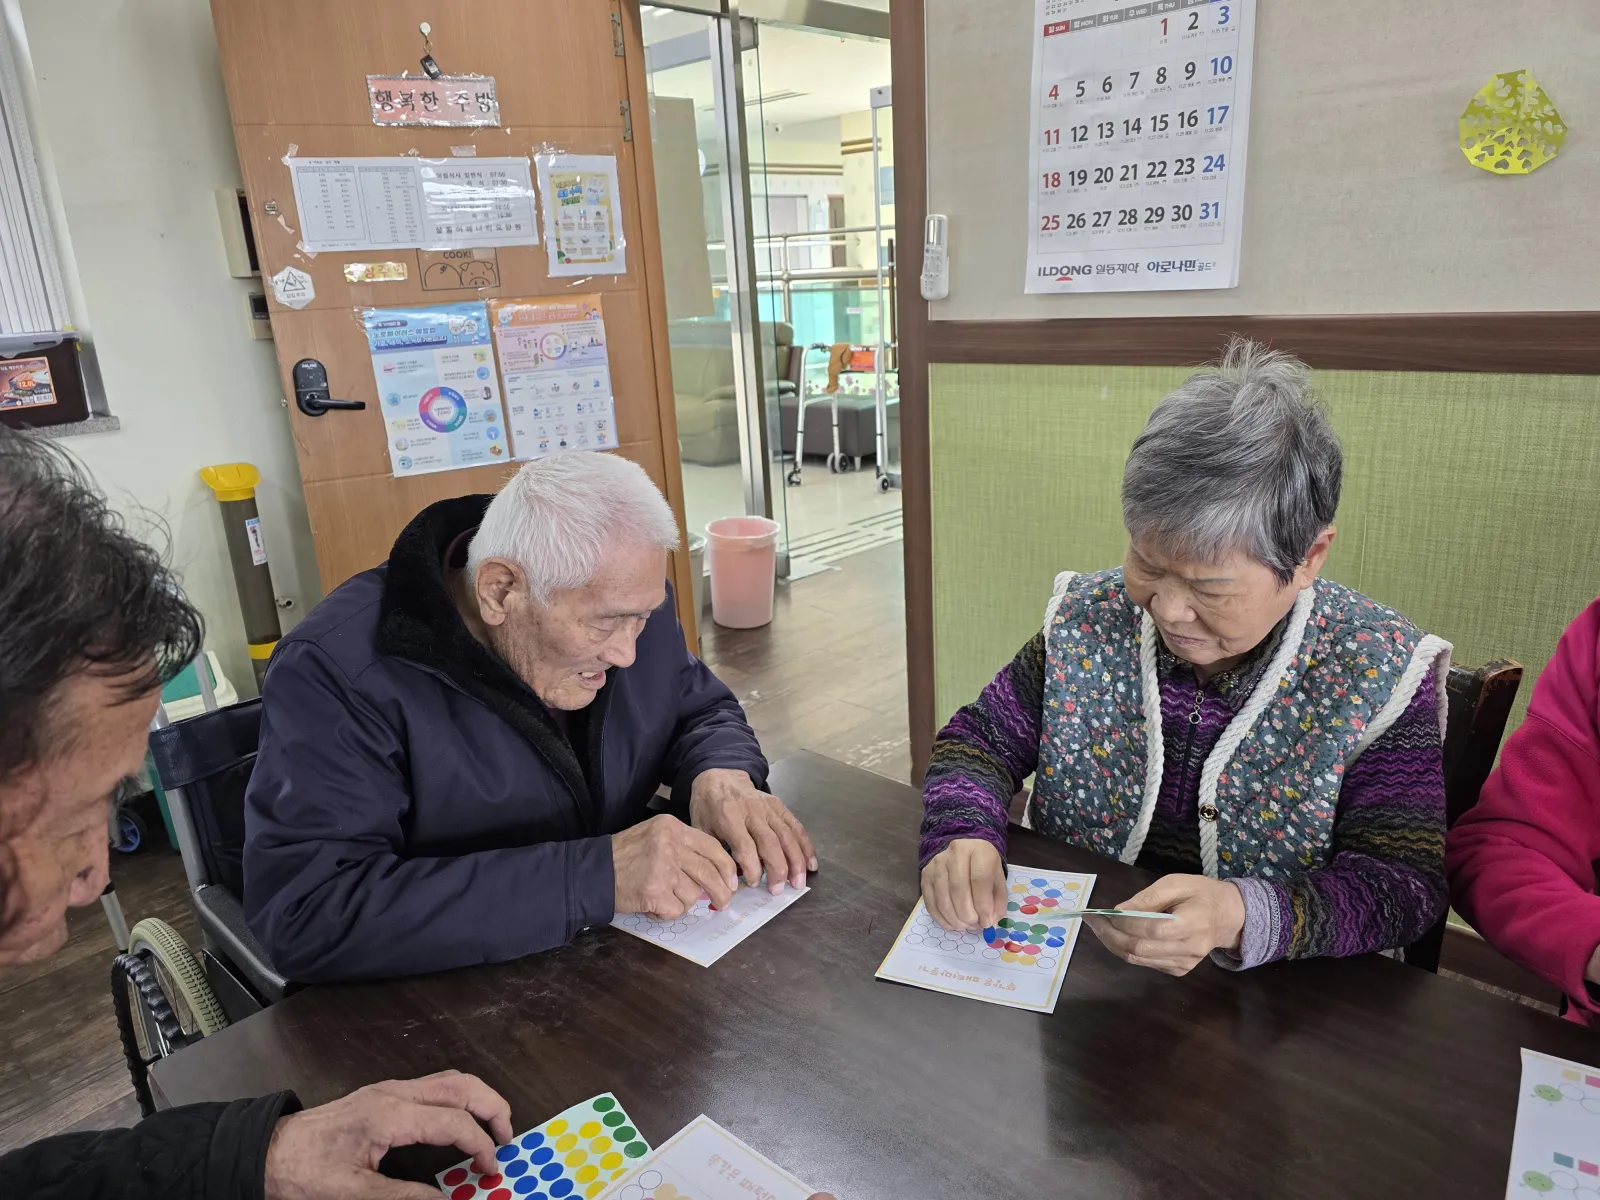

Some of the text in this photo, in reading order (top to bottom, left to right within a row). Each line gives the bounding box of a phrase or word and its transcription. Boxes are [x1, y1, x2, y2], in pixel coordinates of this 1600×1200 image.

[1055, 24, 1066, 32] SUN
[1080, 19, 1094, 27] MON
[1161, 6, 1229, 35] 1 2 3
[1049, 56, 1232, 100] 4 5 6 7 8 9 10
[374, 89, 494, 113] 행복한 주방
[1045, 106, 1229, 145] 11 12 13 14 15 16 17
[1043, 154, 1225, 188] 18 19 20 21 22 23 24
[1042, 202, 1219, 230] 25 26 27 28 29 30 31
[443, 250, 472, 259] COOK!
[1037, 264, 1092, 277] ILDONG
[1095, 262, 1140, 275] 일동제약
[1146, 260, 1196, 273] 아로나민
